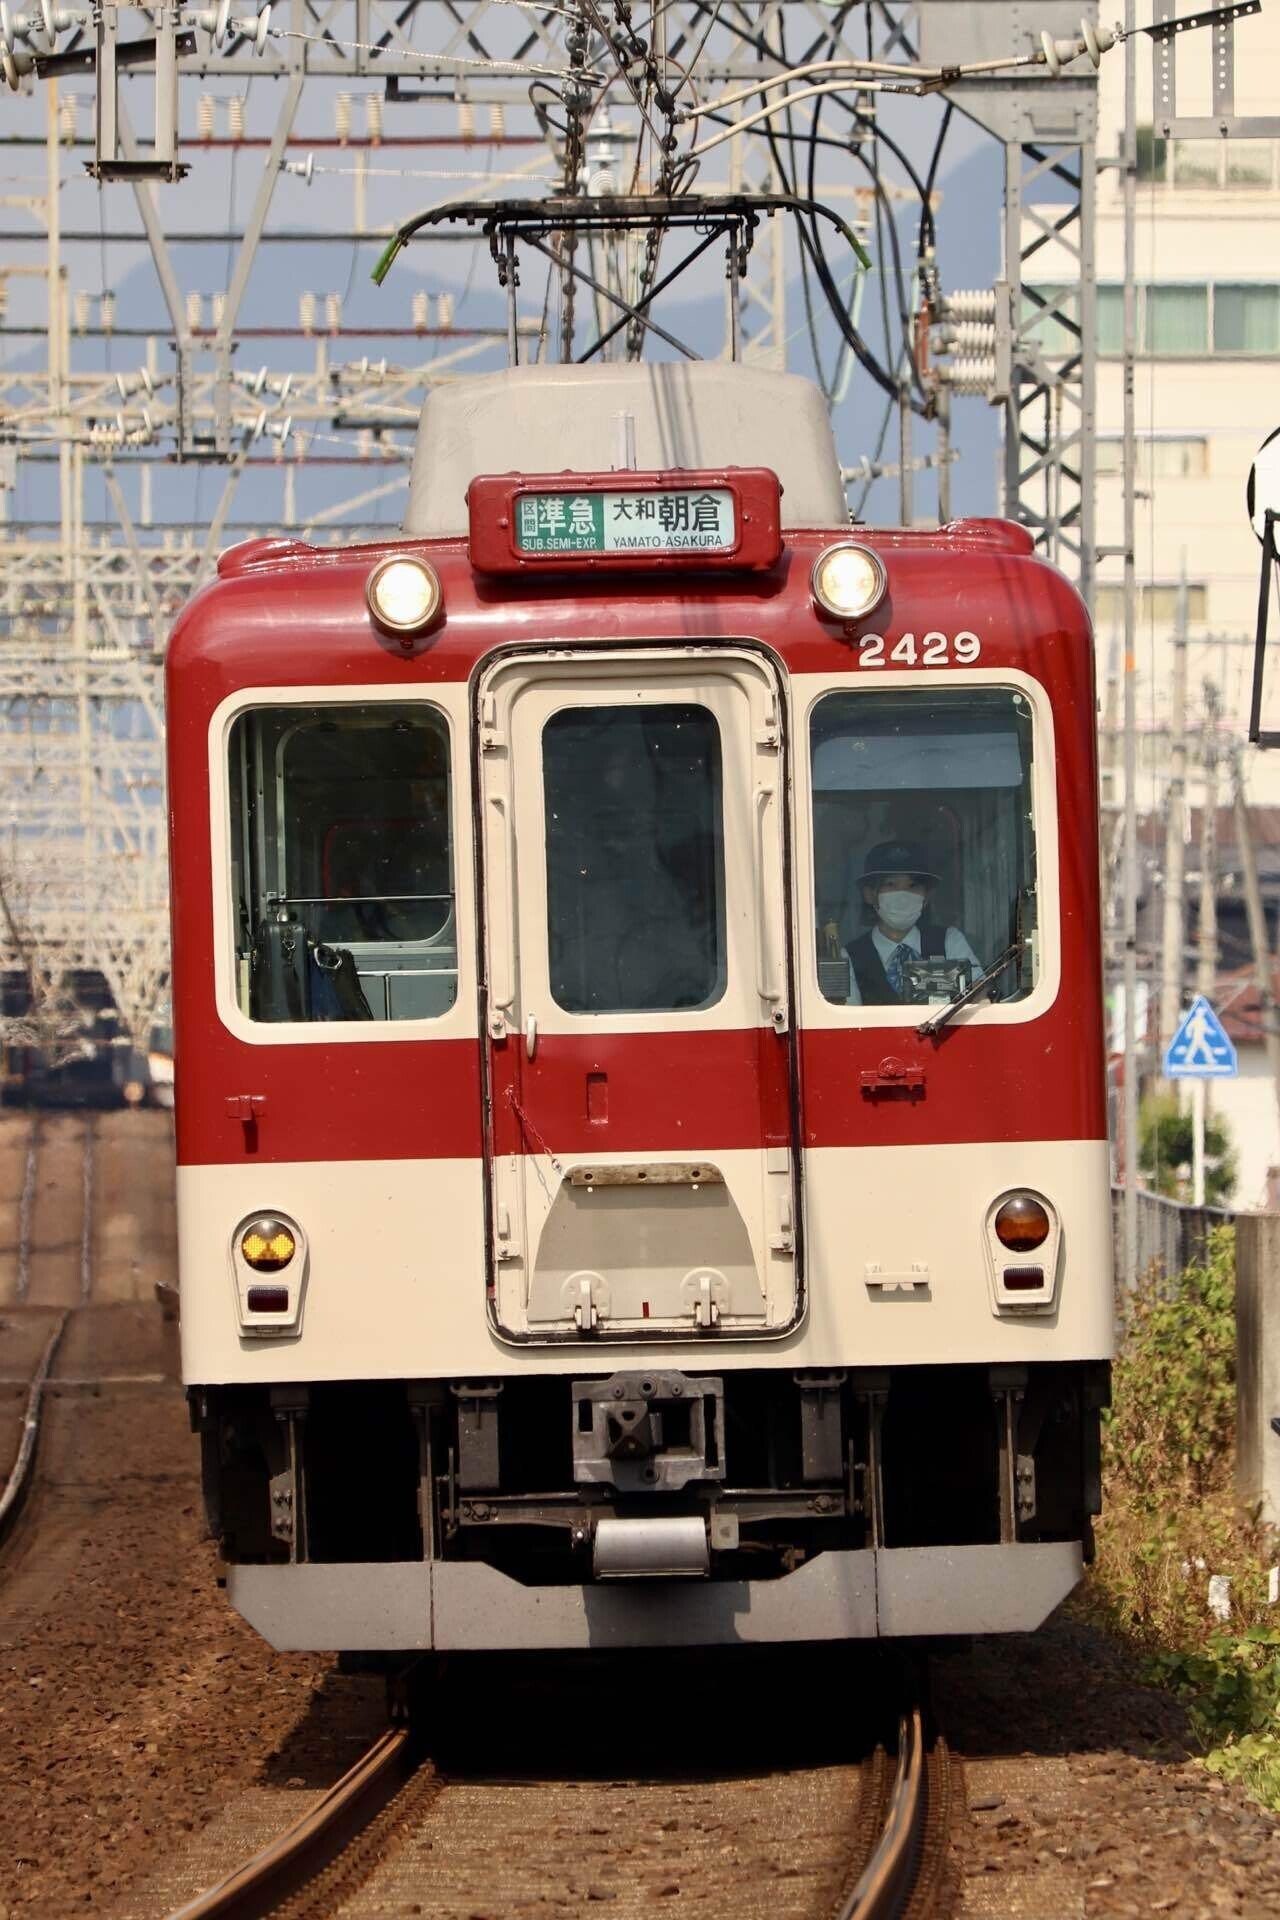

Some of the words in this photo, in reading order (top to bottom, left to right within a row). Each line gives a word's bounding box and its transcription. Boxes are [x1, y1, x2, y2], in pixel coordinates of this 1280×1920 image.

[538, 497, 596, 536] 準急
[613, 493, 722, 533] 大和朝倉
[613, 535, 723, 549] YAMATO-ASAKURA
[858, 631, 981, 667] 2429
